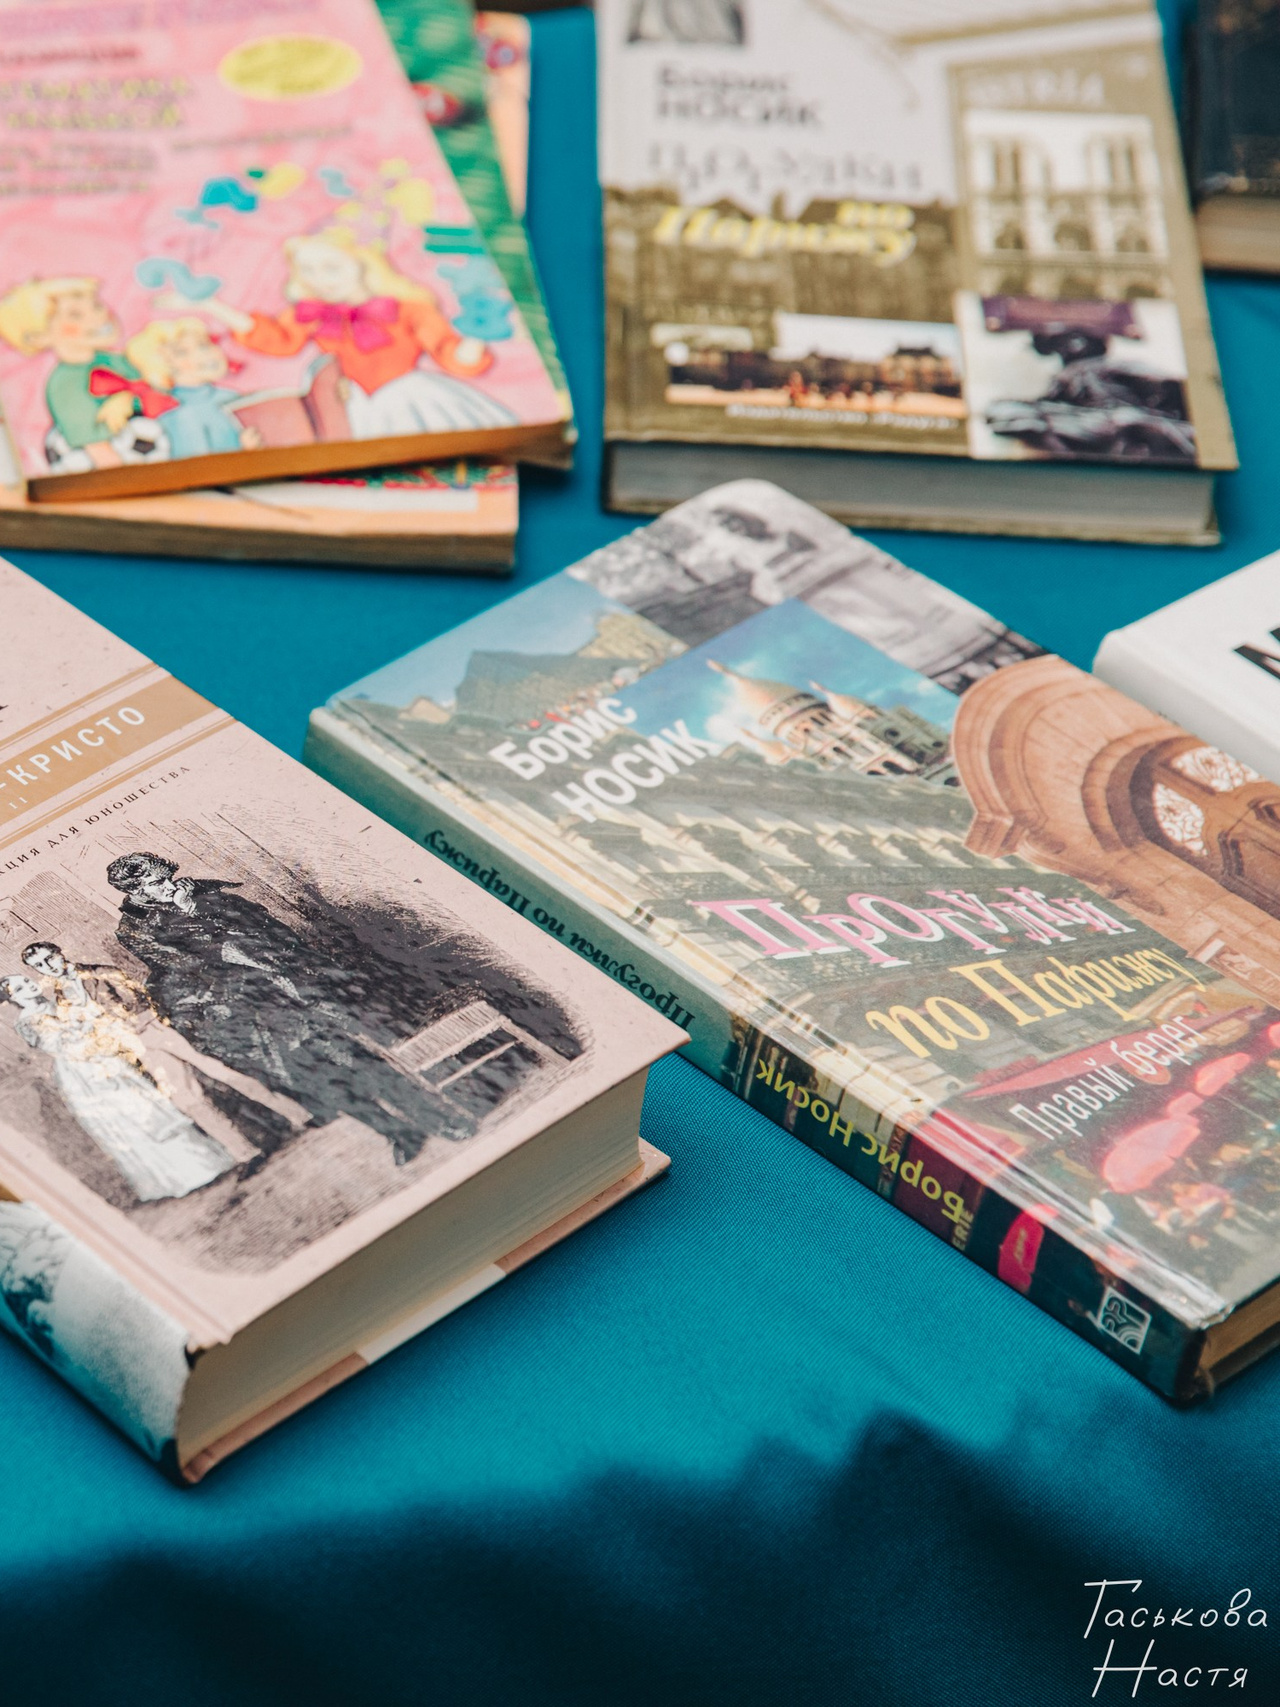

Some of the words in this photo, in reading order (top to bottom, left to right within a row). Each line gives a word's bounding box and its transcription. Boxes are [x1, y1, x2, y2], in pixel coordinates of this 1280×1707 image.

[657, 96, 822, 126] НОСИК
[488, 697, 638, 781] Борис
[551, 719, 721, 823] НОСИК
[46, 824, 80, 850] ДЛЯ
[84, 764, 191, 827] ЮНОШЕСТВА
[423, 829, 532, 916] Парижу
[865, 998, 990, 1059] по
[950, 945, 1207, 1027] Парижу
[756, 1056, 855, 1147] Носик
[1009, 1058, 1136, 1143] Правый
[1119, 1012, 1206, 1078] берег
[860, 1136, 967, 1224] Борис
